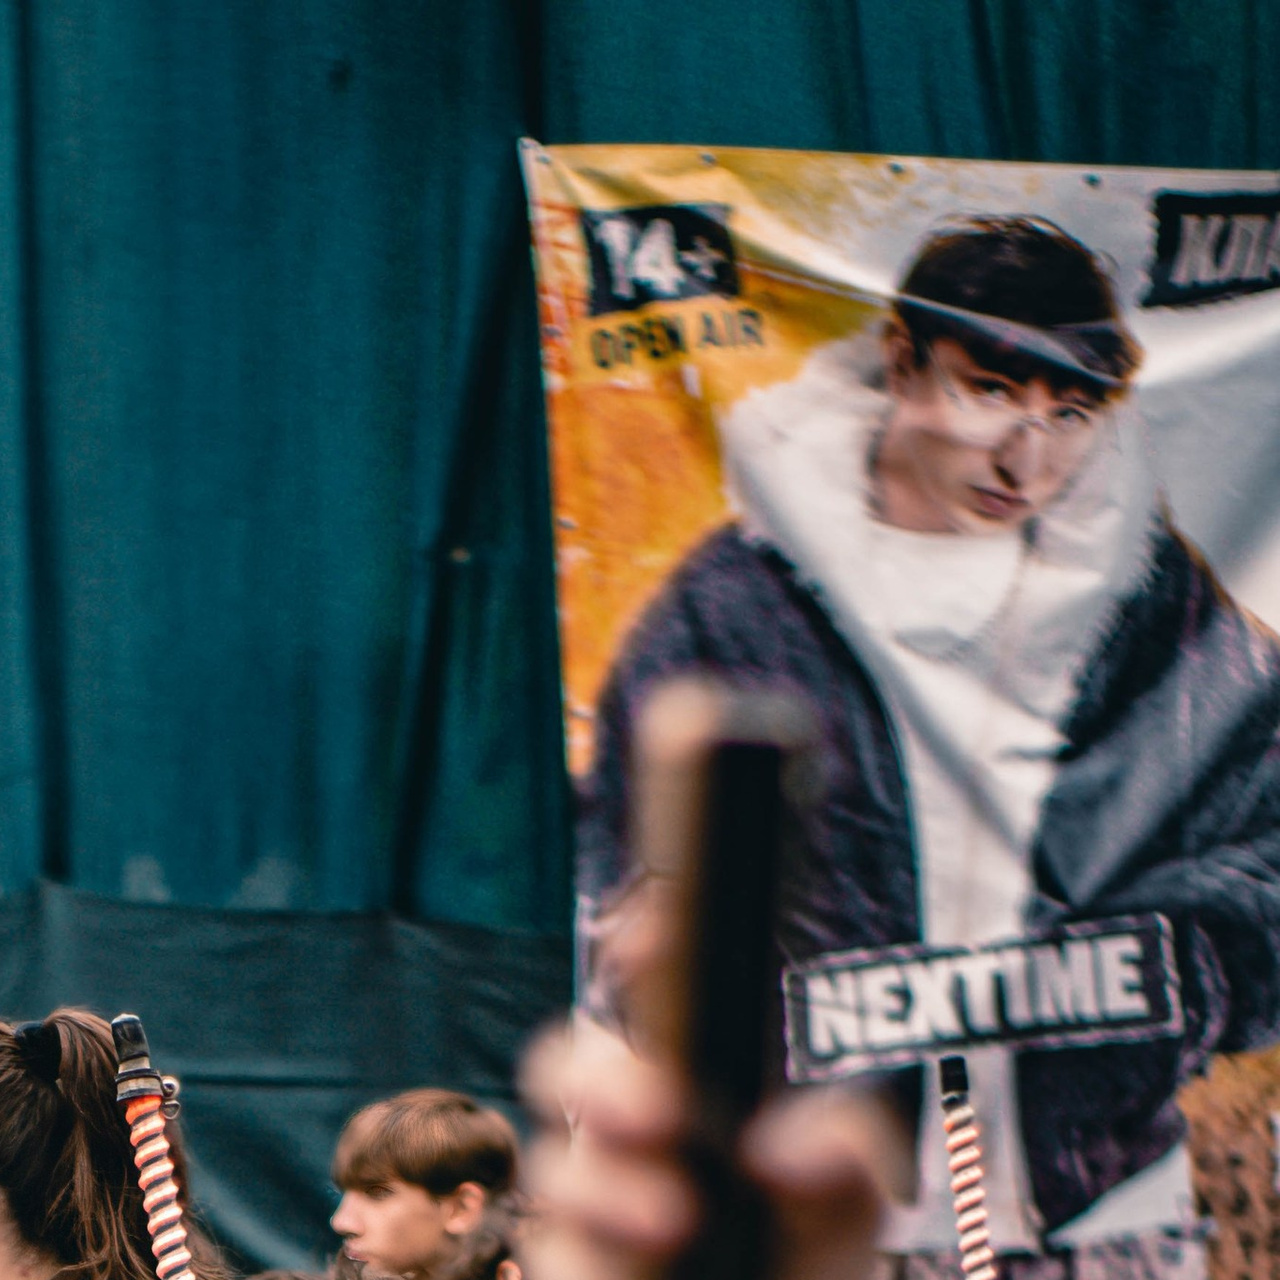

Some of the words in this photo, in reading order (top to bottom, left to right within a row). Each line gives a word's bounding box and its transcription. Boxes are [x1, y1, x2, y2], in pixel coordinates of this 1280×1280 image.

[594, 217, 724, 298] 14+
[590, 317, 689, 370] OPEN
[699, 309, 765, 348] AIR
[805, 932, 1150, 1058] NEXTIME
